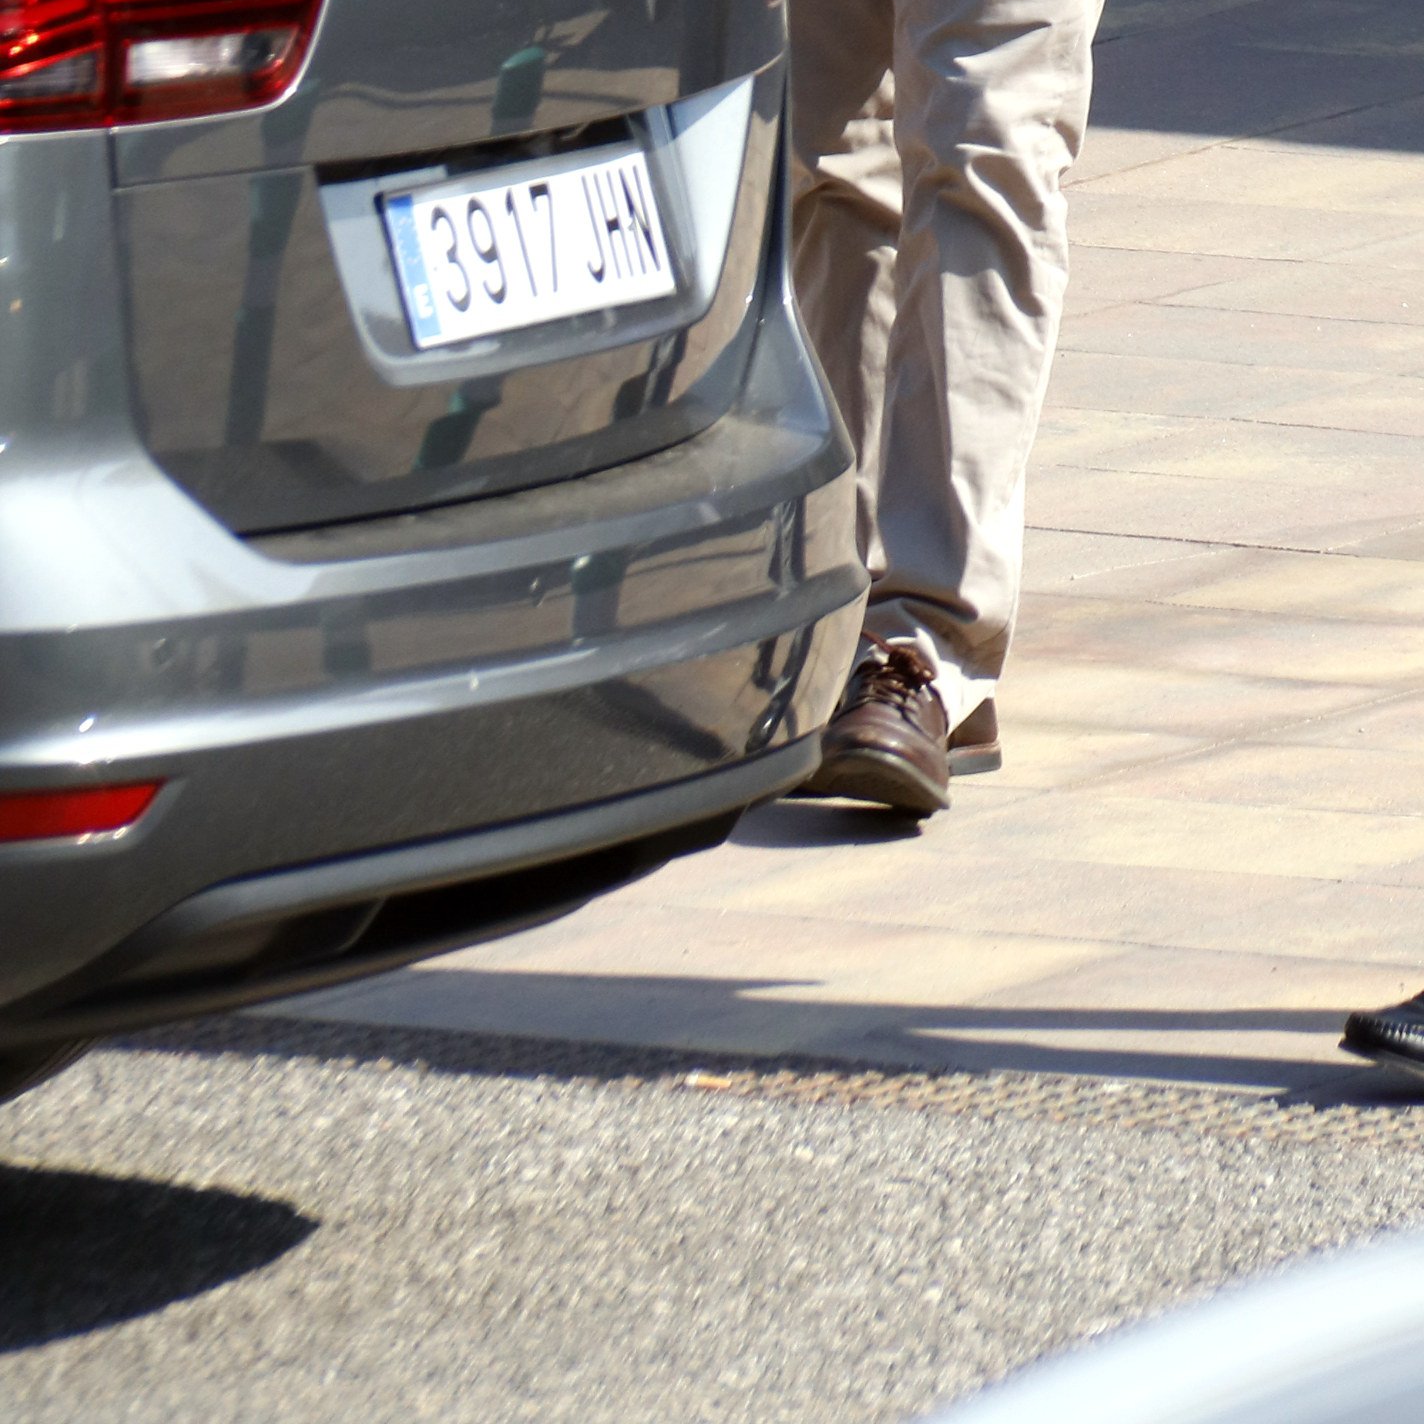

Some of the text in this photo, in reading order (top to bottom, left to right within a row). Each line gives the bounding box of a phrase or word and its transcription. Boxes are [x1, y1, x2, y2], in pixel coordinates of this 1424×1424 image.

[430, 164, 662, 312] 3917 JHN
[411, 282, 434, 319] E
